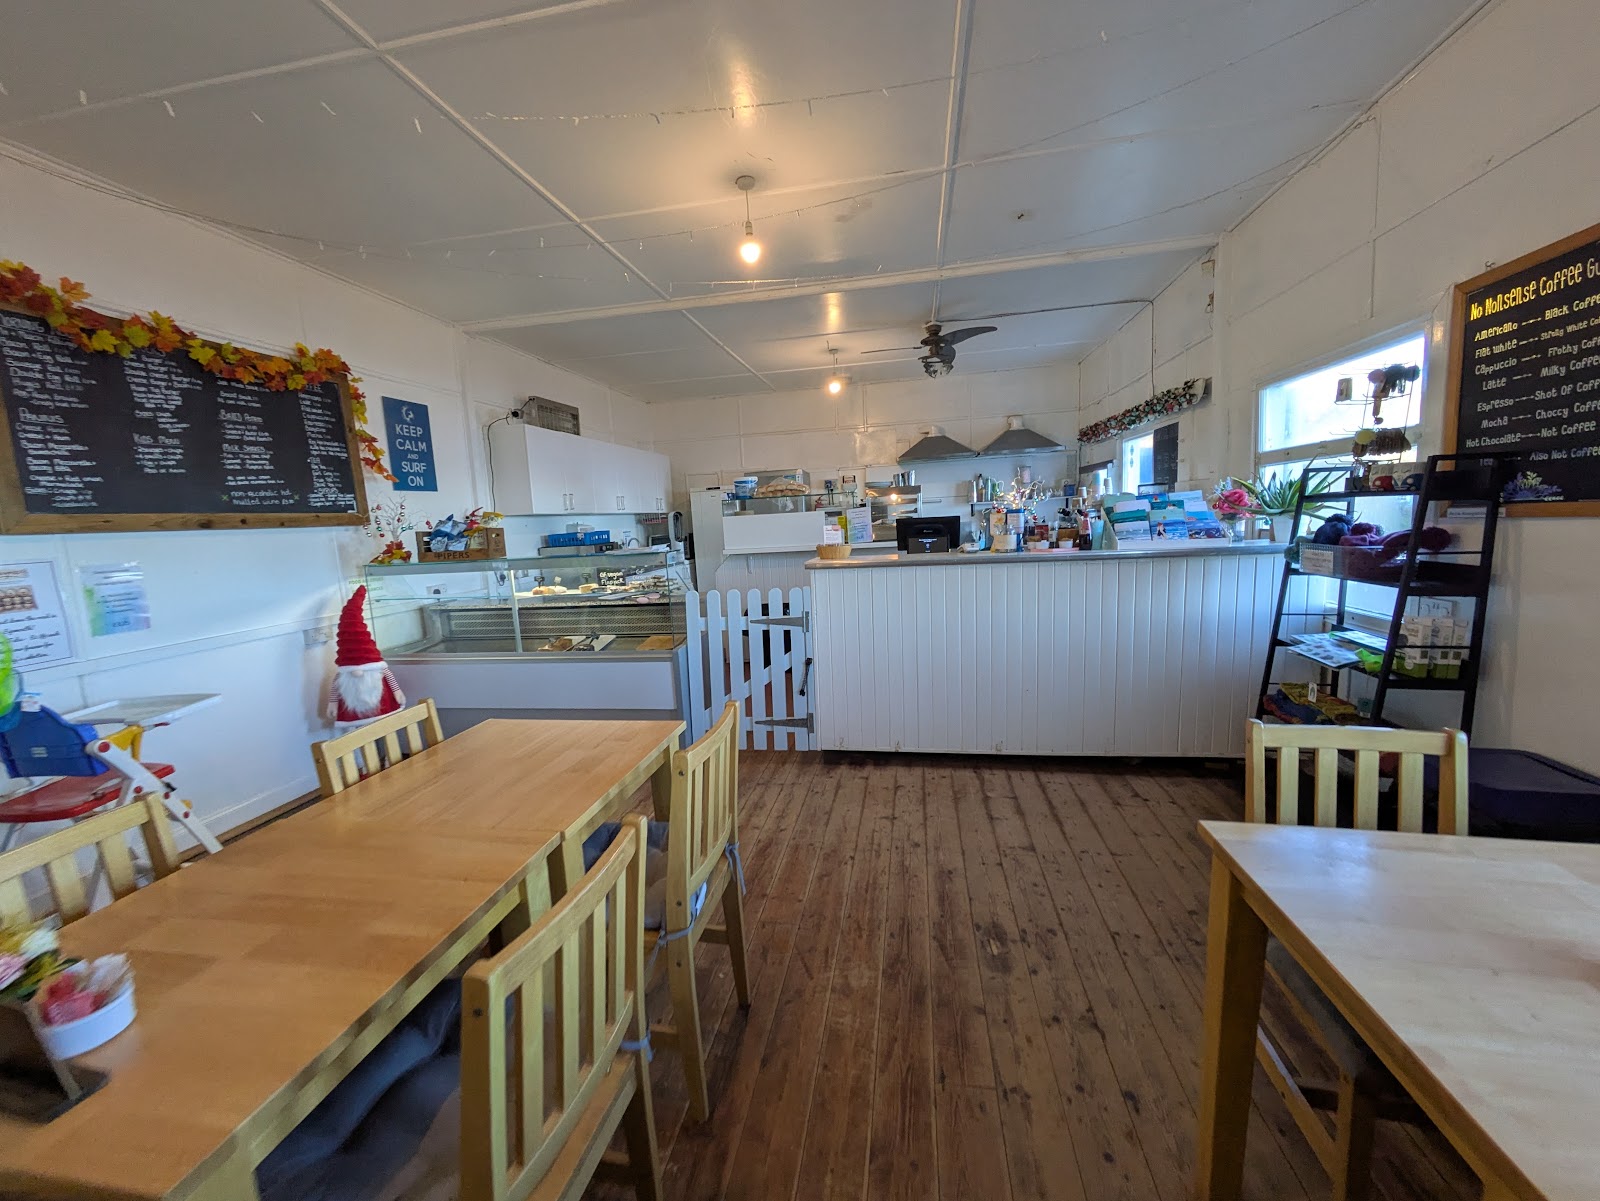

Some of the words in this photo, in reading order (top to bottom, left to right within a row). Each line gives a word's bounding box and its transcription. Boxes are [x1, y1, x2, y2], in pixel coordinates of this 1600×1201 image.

[1470, 302, 1483, 321] No
[1484, 280, 1537, 316] Nonsense
[1539, 262, 1583, 296] Coffee
[1474, 322, 1518, 342] Americano
[1544, 305, 1569, 320] Black
[1475, 346, 1491, 358] Flat
[1547, 343, 1579, 358] Frothy
[1482, 377, 1507, 391] Latte
[1540, 365, 1566, 378] Milky
[1569, 355, 1600, 371] Coffe
[1477, 399, 1514, 412] Espresso
[1534, 387, 1558, 401] Shot
[1481, 416, 1509, 429] Mocha
[1535, 407, 1569, 420] Choccy
[395, 423, 423, 438] KEEP
[1466, 438, 1480, 448] Hot
[1480, 432, 1521, 446] Chocolate
[1541, 427, 1558, 438] Not
[1561, 420, 1597, 435] Coffee
[395, 438, 427, 452] CALM
[1529, 451, 1549, 461] Also
[1551, 449, 1568, 459] Not
[401, 461, 427, 474] SURF
[407, 475, 424, 487] ON
[437, 551, 470, 560] PIPERS
